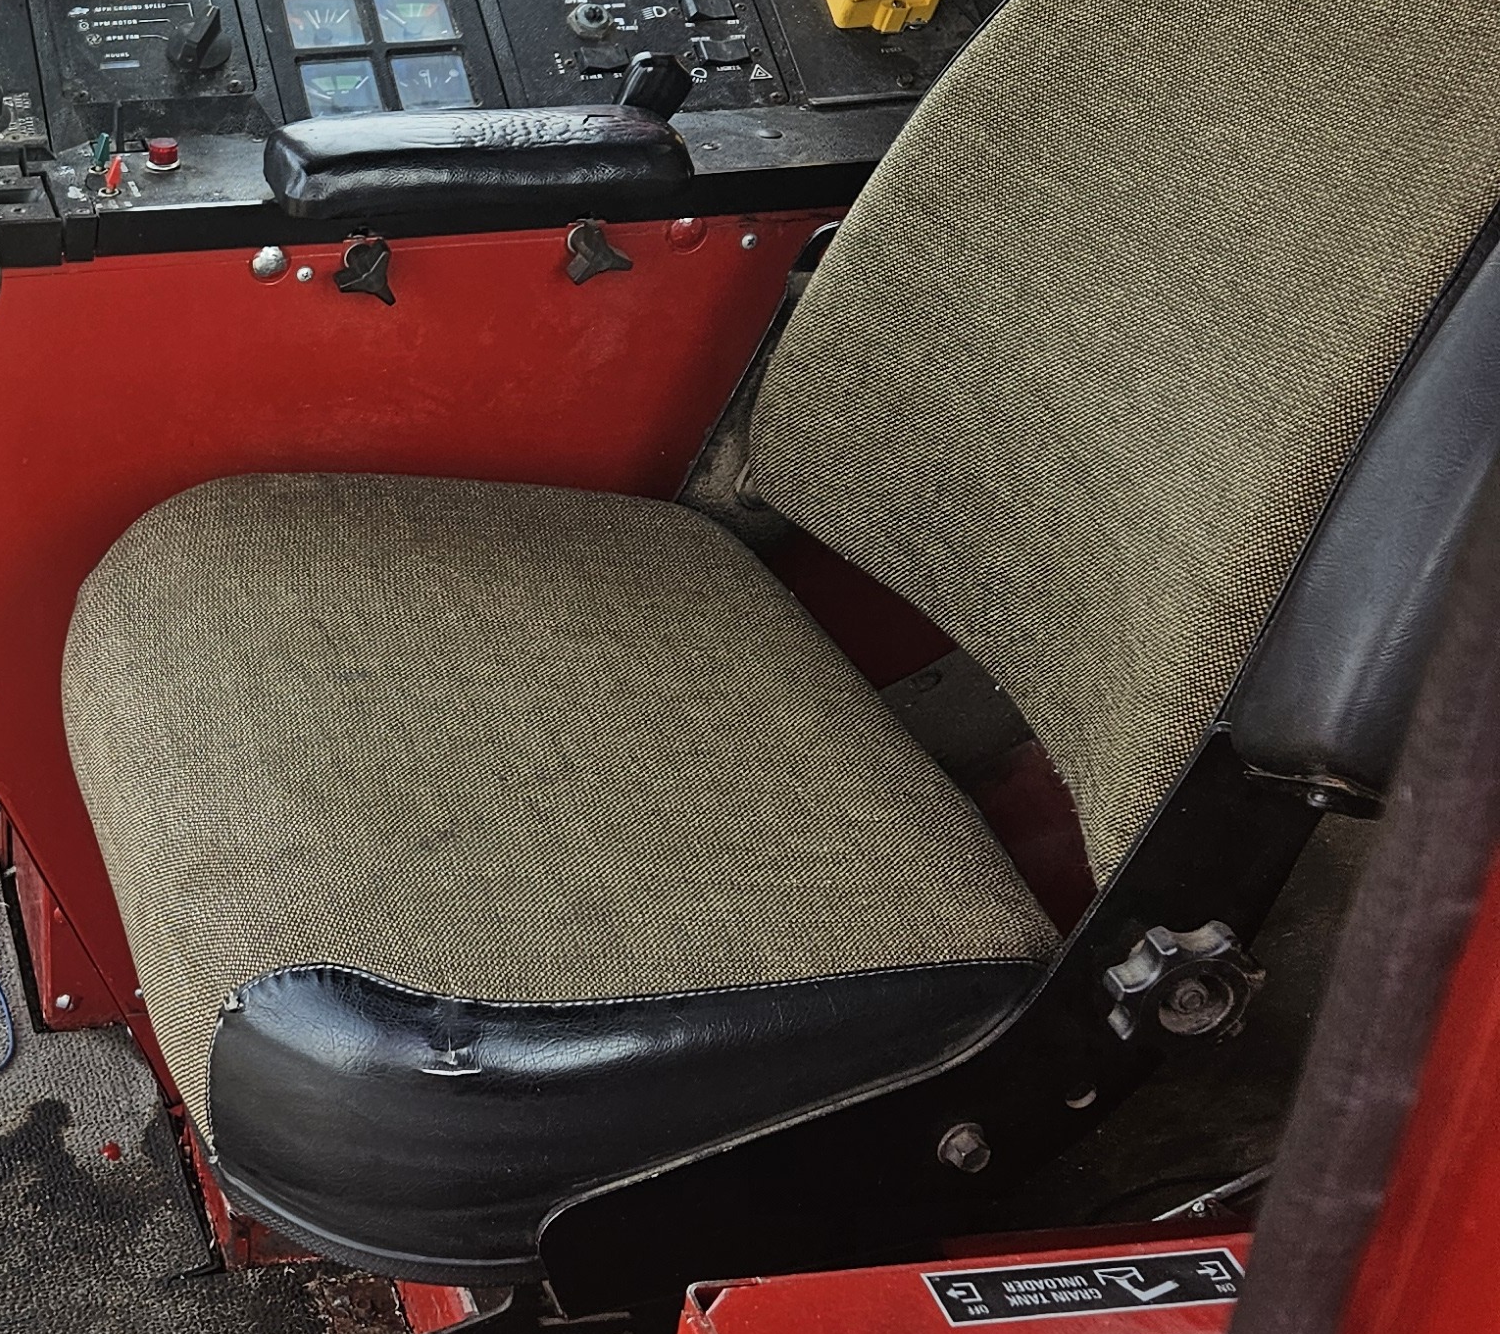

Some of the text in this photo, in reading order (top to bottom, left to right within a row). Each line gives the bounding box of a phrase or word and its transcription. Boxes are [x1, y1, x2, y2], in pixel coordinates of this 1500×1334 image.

[1002, 1275, 1089, 1295] UNLOADER
[1216, 1283, 1238, 1294] ON
[1006, 1286, 1103, 1308] GRAIN TANK
[967, 1303, 991, 1316] OFF
